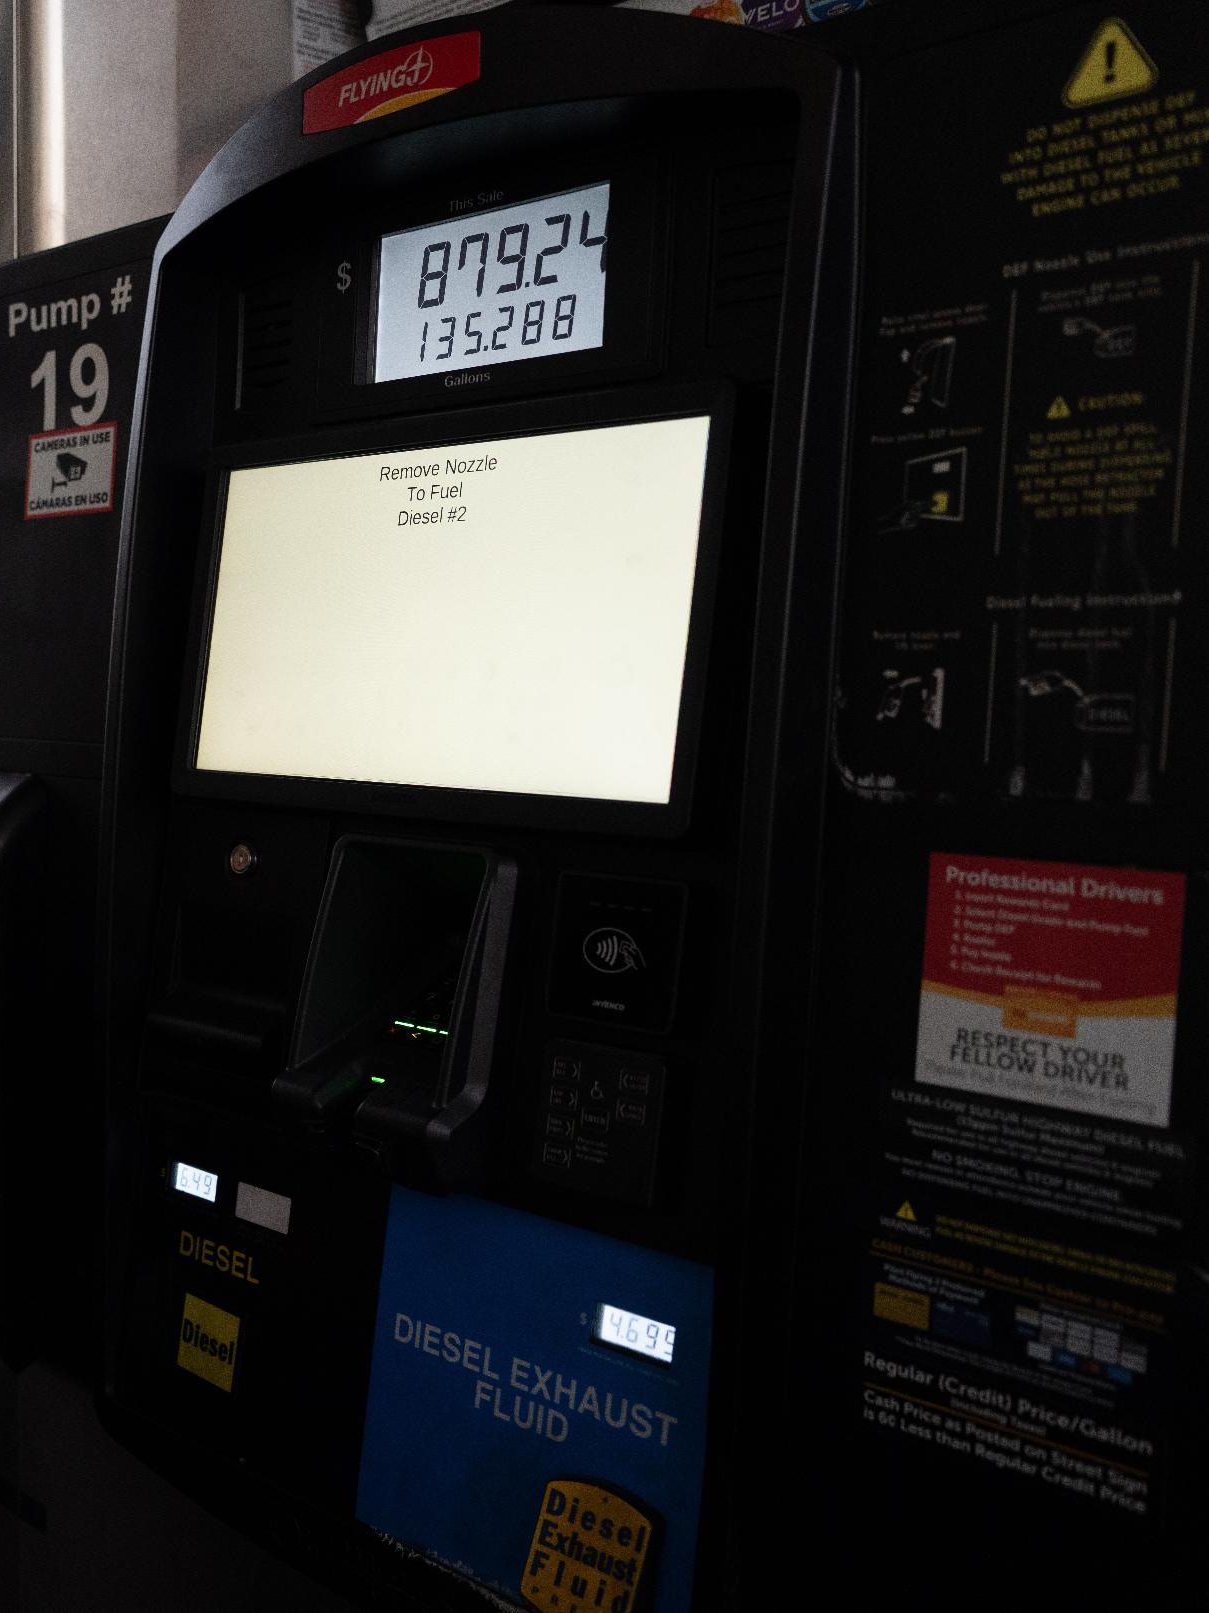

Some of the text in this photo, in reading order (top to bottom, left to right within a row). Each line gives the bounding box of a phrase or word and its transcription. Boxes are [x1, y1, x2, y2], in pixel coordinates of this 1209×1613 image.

[744, 0, 800, 25] VELO
[338, 66, 410, 108] FLYING
[1008, 144, 1043, 164] INTO
[1046, 132, 1095, 157] DIESEL
[1099, 120, 1150, 146] TANKS
[1153, 114, 1178, 135] OR
[1026, 89, 1195, 144] DO NOT DISPENSE DEF
[999, 165, 1039, 186] WITH
[1043, 153, 1091, 177] DIESEL
[1096, 144, 1133, 167] FUEL
[1016, 174, 1076, 202] DAMAGE
[1078, 169, 1100, 189] TO
[1103, 163, 1132, 184] THE
[448, 188, 505, 215] This Sale
[1030, 173, 1182, 218] ENGINE CAN OCCUR
[337, 259, 352, 296] $
[418, 209, 608, 310] 879.24
[1001, 260, 1029, 279] DEF
[1032, 255, 1081, 273] Nozzle
[1084, 249, 1113, 265] Use
[8, 275, 133, 338] Pump #
[421, 293, 577, 364] 135.288
[31, 341, 110, 431] 19
[444, 370, 492, 389] Gallons
[1077, 390, 1145, 413] CAUTION
[34, 430, 112, 454] CAMERAS IN USE
[379, 454, 500, 483] Remove Nozzle
[75, 494, 88, 507] EN
[89, 491, 109, 506] USO
[407, 481, 464, 502] To Fuel
[397, 504, 468, 527] Diesel #2
[986, 595, 1027, 611] Diesel
[945, 864, 1166, 907] Professional Drivers
[950, 1043, 1039, 1076] FELLOW
[1042, 1059, 1131, 1092] DRIVER
[956, 1026, 1127, 1071] RESPECT YOUR
[891, 1088, 1186, 1161] ULTRA-LOW SULFUR HIGHWAY DIESEL FUEL
[931, 1148, 953, 1165] NO
[1024, 1168, 1064, 1189] STOP
[871, 1237, 903, 1255] CASH
[879, 1215, 932, 1240] WARNING
[178, 1229, 260, 1285] DIESEL
[181, 1318, 236, 1367] Diesel
[393, 1312, 501, 1381] DIESEL
[509, 1354, 679, 1447] EXHAUST
[473, 1378, 570, 1443] FLUID
[863, 1350, 934, 1386] Regular
[938, 1373, 1013, 1413] (Credit)
[1017, 1397, 1154, 1458] Price/Gallon
[863, 1388, 1150, 1497] Cash Price as Posted on Street Sign
[863, 1405, 876, 1422] is
[899, 1416, 933, 1441] Less
[934, 1430, 972, 1454] than
[974, 1442, 1039, 1477] Regular
[1040, 1465, 1096, 1498] Credit
[1099, 1484, 1149, 1516] Price
[547, 1487, 647, 1554] Diesel
[536, 1518, 636, 1586] Exhaust
[529, 1550, 630, 1613] Fluid
